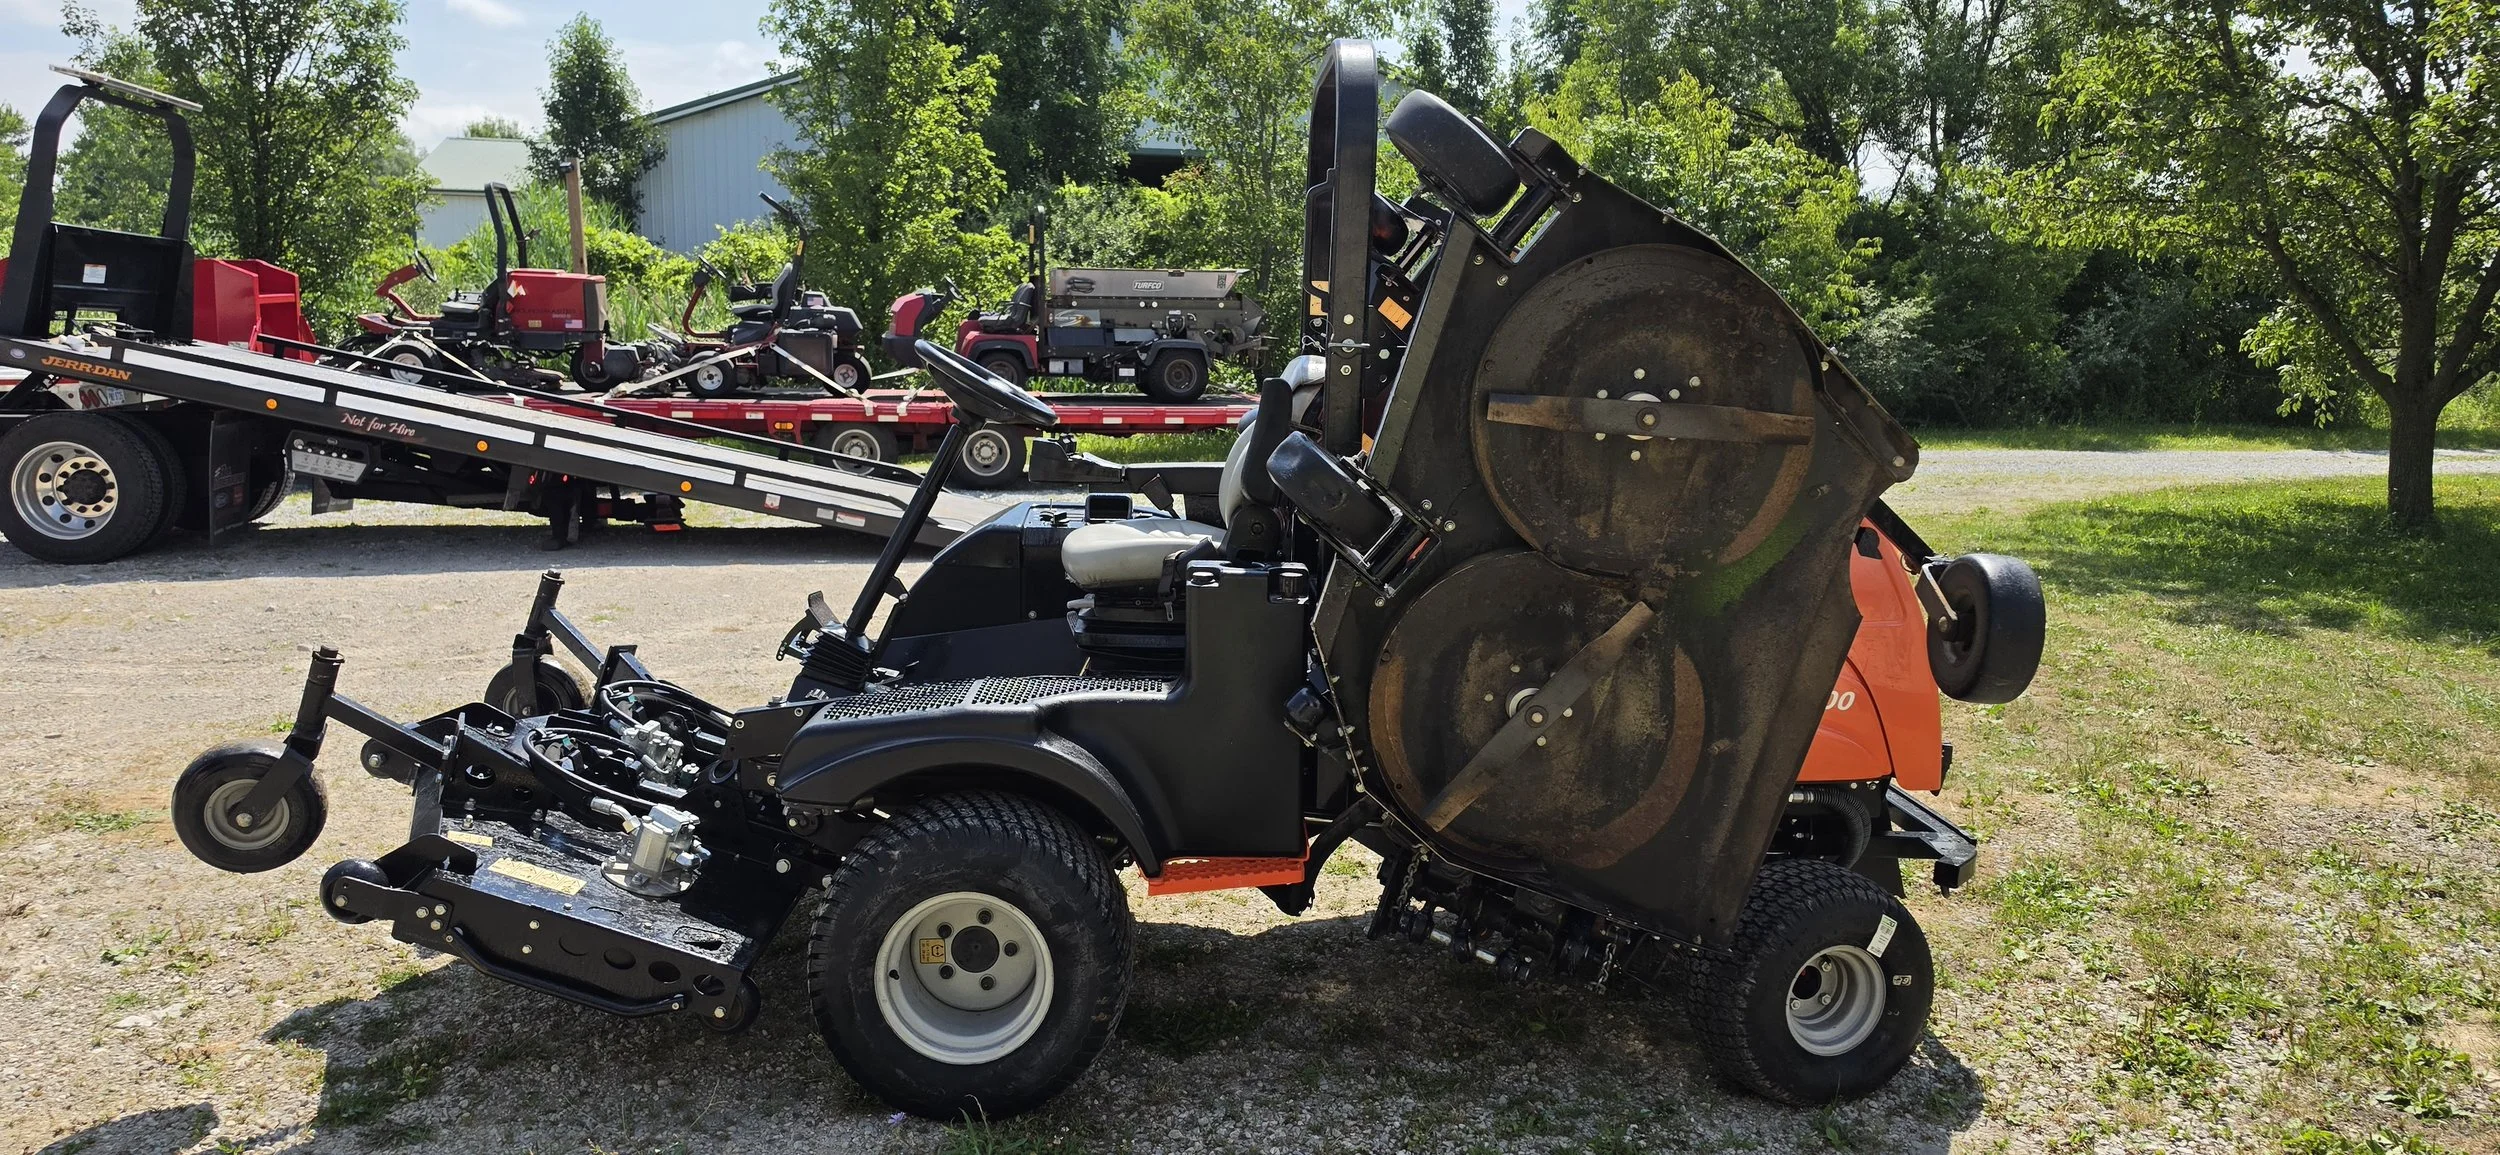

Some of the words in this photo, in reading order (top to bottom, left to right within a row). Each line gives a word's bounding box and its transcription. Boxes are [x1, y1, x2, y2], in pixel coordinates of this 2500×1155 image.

[341, 412, 366, 427] Not
[366, 417, 387, 432] for
[388, 422, 416, 437] Hire
